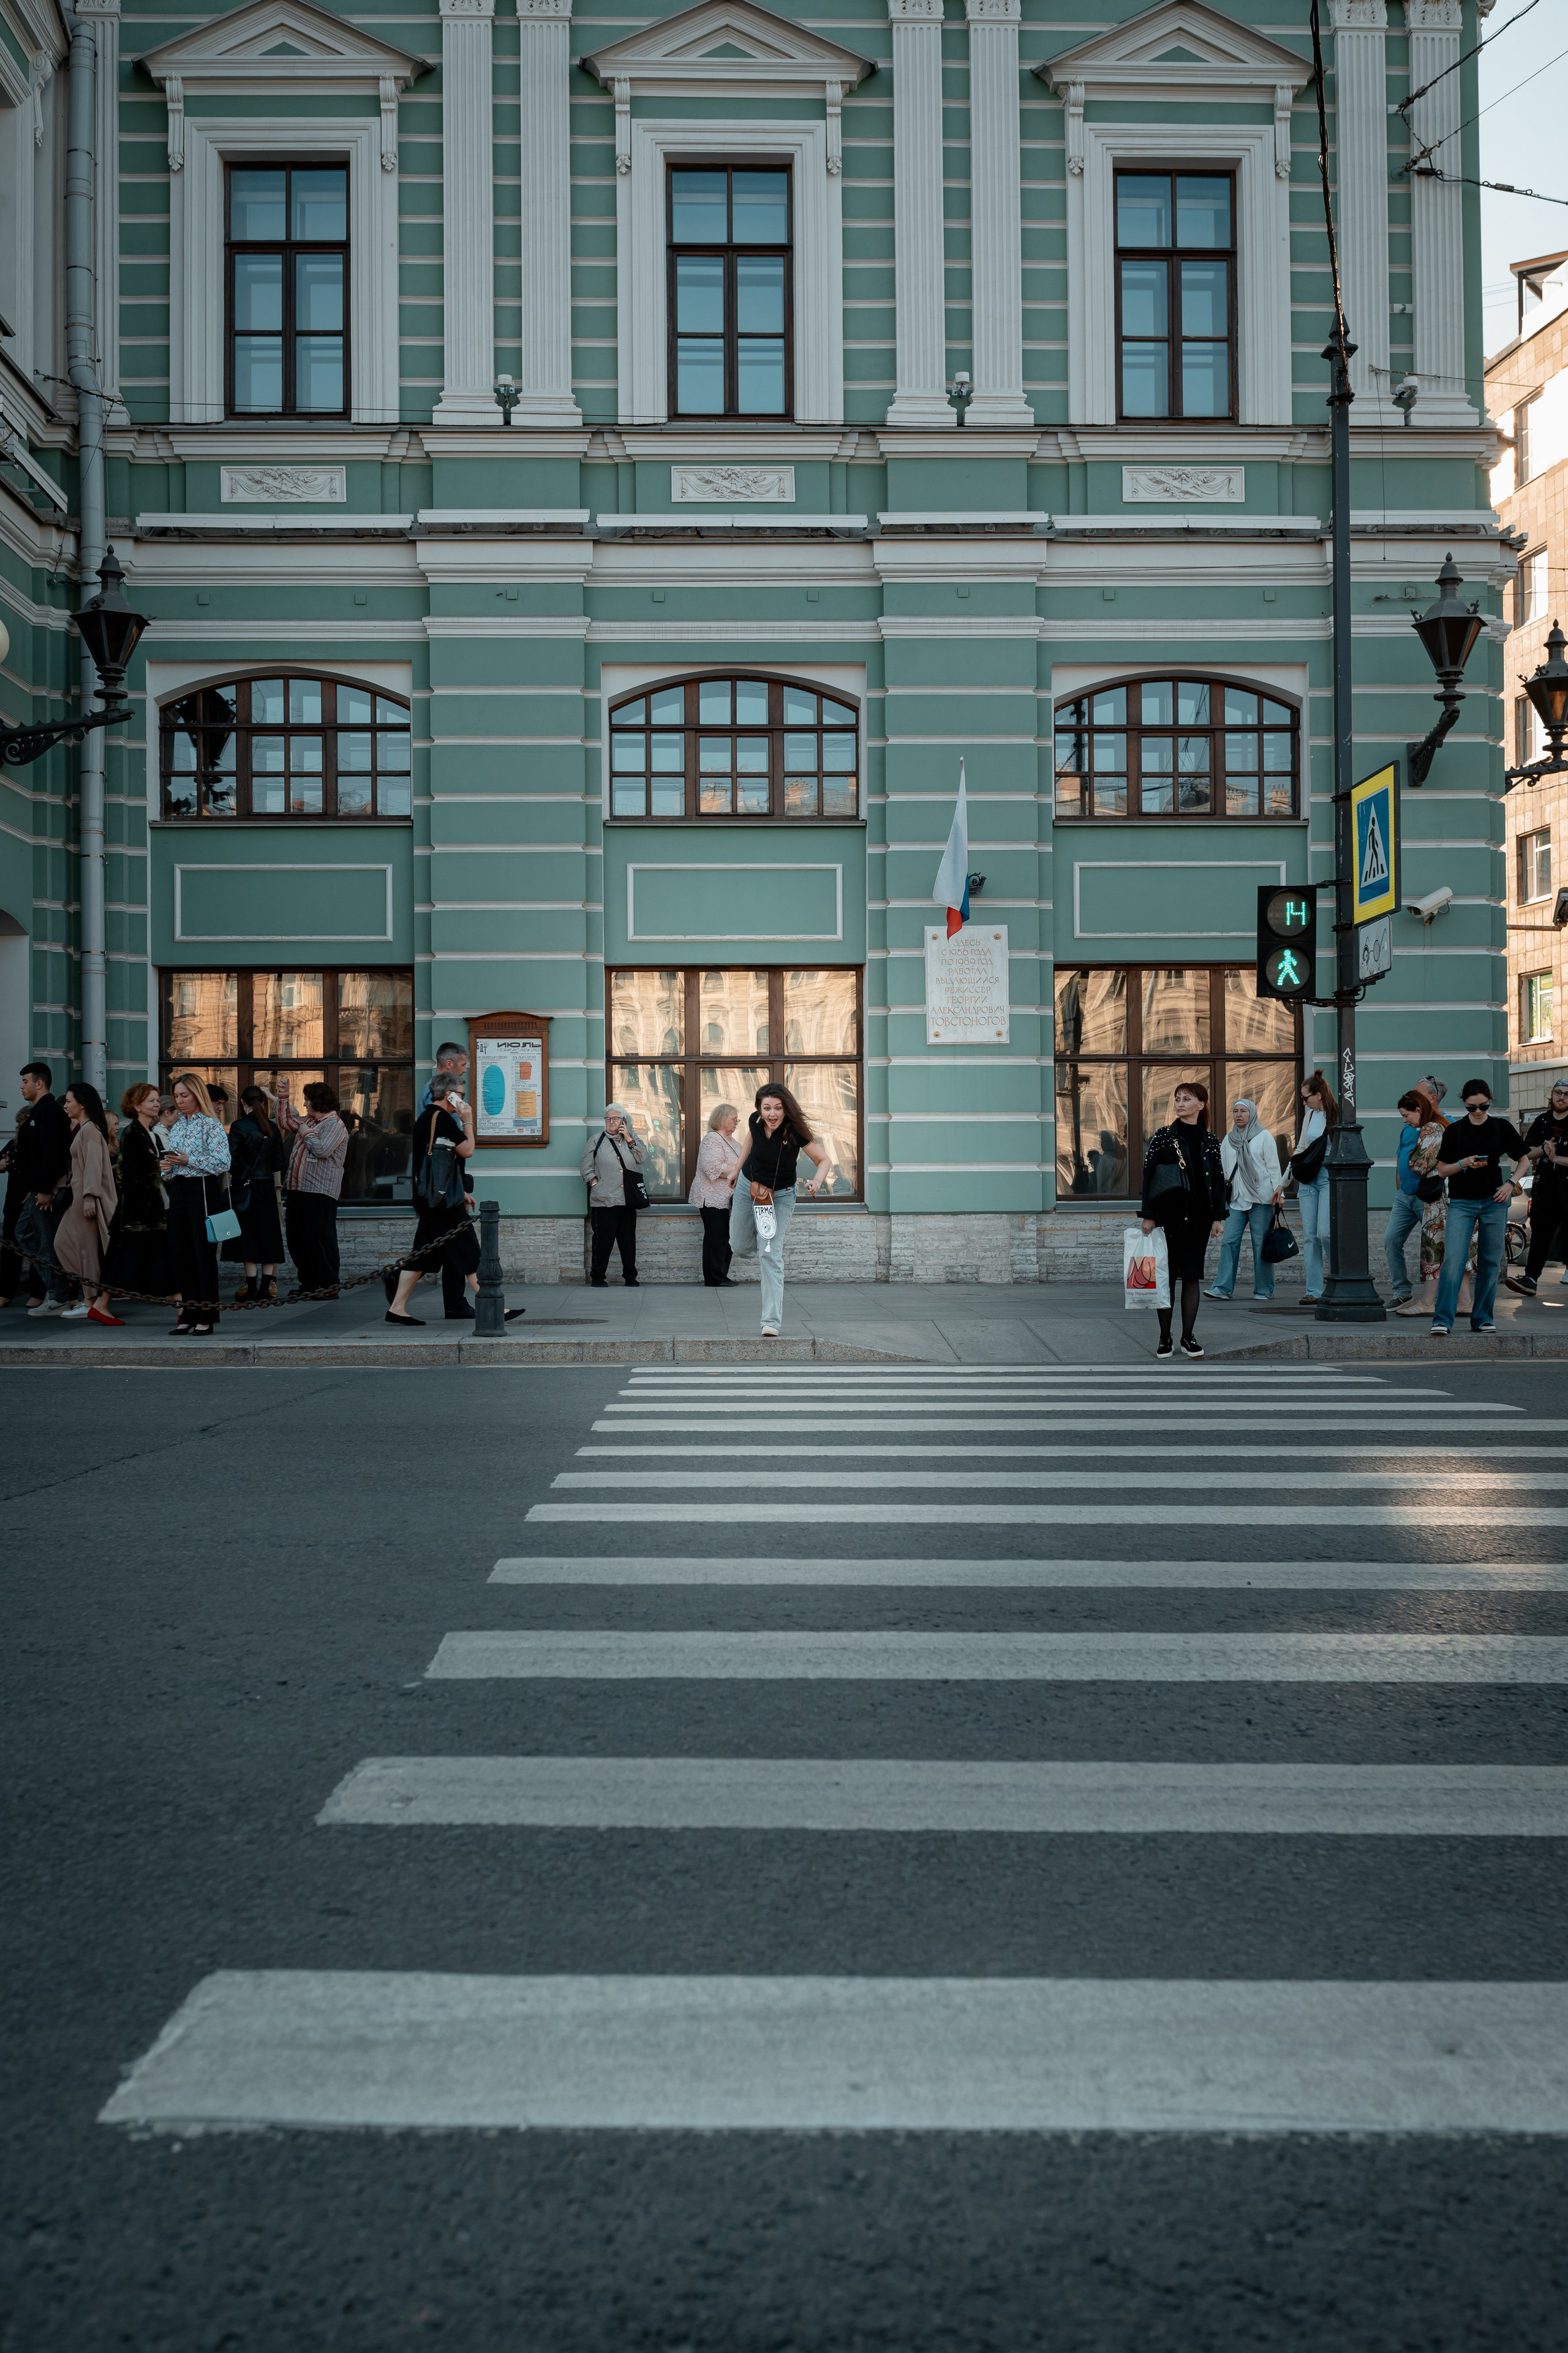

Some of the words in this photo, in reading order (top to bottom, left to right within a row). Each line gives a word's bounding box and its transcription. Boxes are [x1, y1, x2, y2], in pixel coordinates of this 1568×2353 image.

[1286, 901, 1306, 926] 14
[953, 939, 981, 948] ЗДЕСЬ
[949, 948, 969, 957] 1956
[970, 948, 992, 957] ГОДА
[956, 957, 976, 967] 1989
[948, 967, 987, 976] РАБОТАЛ
[944, 986, 991, 995] РЕЖИССЕР
[947, 995, 987, 1005] ГЕОРГИЙ
[930, 1006, 1005, 1015] АЛЕКСАНДРОВИЧ
[930, 1016, 1006, 1026] ТОВСТОНОГОВ
[755, 1206, 774, 1220] FIRMA
